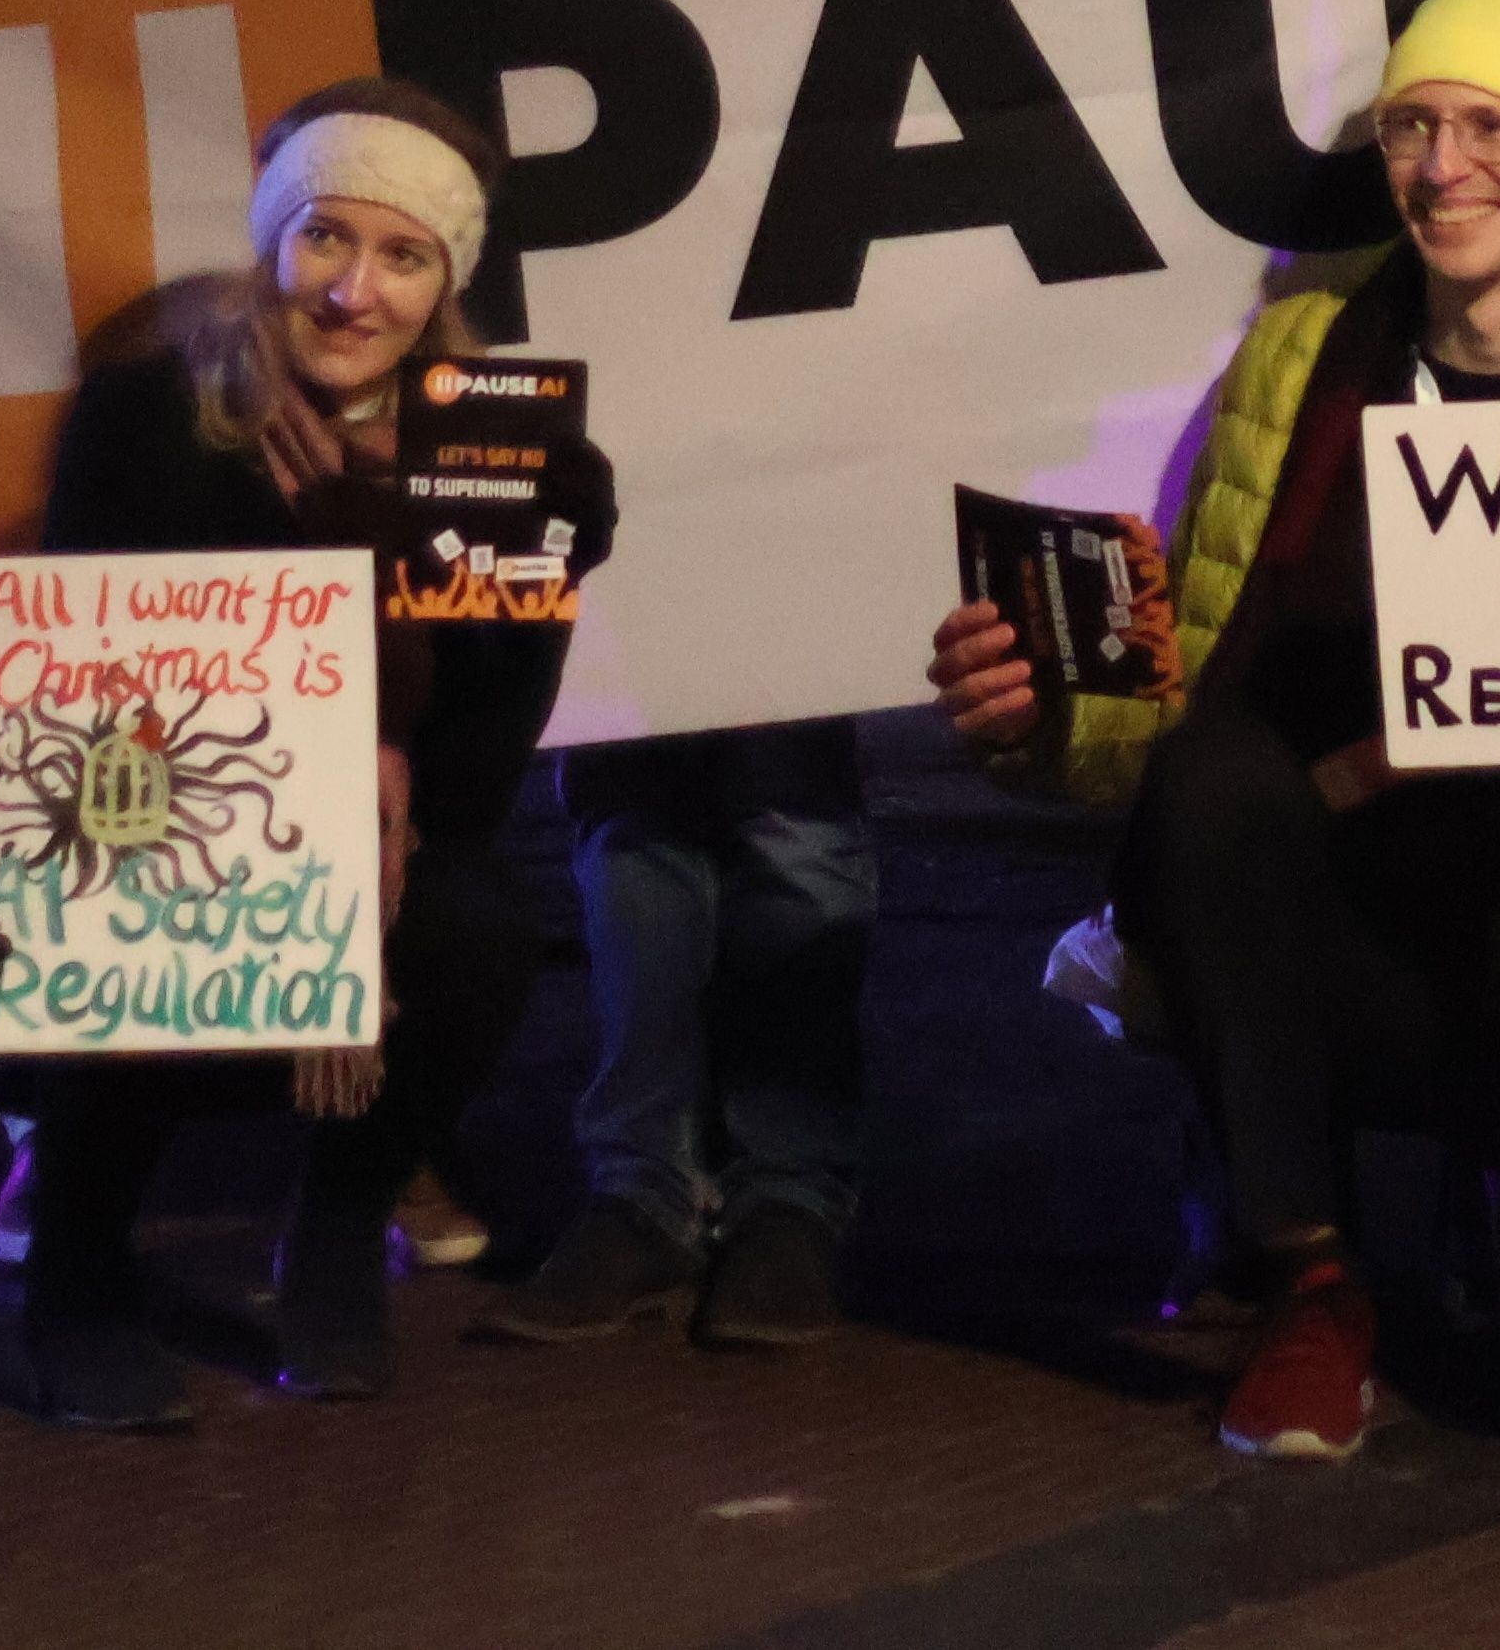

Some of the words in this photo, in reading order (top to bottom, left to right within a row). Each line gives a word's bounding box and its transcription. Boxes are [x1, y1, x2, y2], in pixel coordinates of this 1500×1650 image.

[408, 476, 431, 497] TO
[433, 477, 537, 499] SUPERHUM
[96, 572, 110, 628] I
[128, 573, 258, 626] want
[255, 567, 352, 650] for
[294, 638, 344, 699] is
[107, 848, 361, 978] Safety
